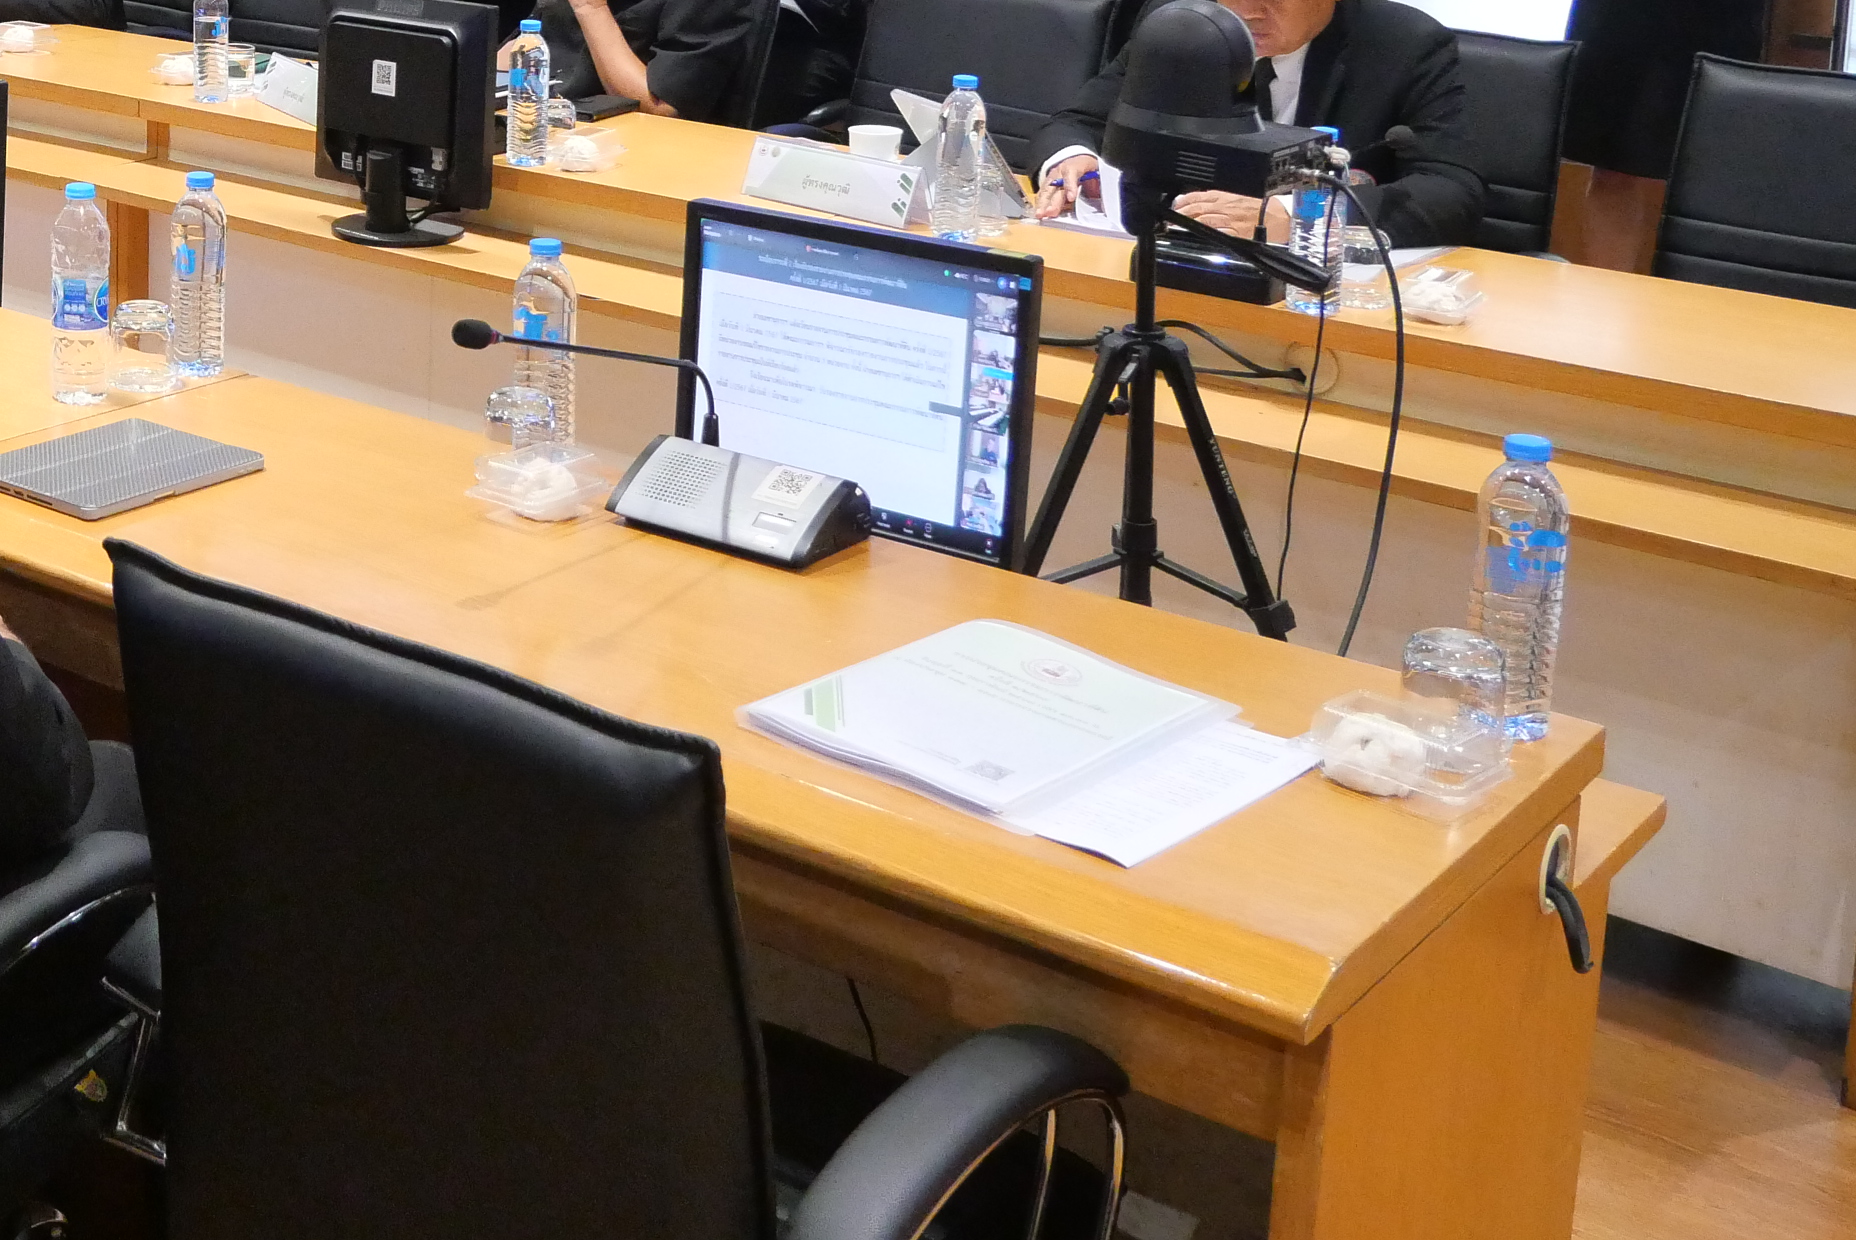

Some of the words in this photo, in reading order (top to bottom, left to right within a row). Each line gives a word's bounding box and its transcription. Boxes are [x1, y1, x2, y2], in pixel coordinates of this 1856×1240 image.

[801, 174, 851, 198] ผู้ทรงคุณวุฒิ
[1209, 438, 1234, 495] YUNTENG
